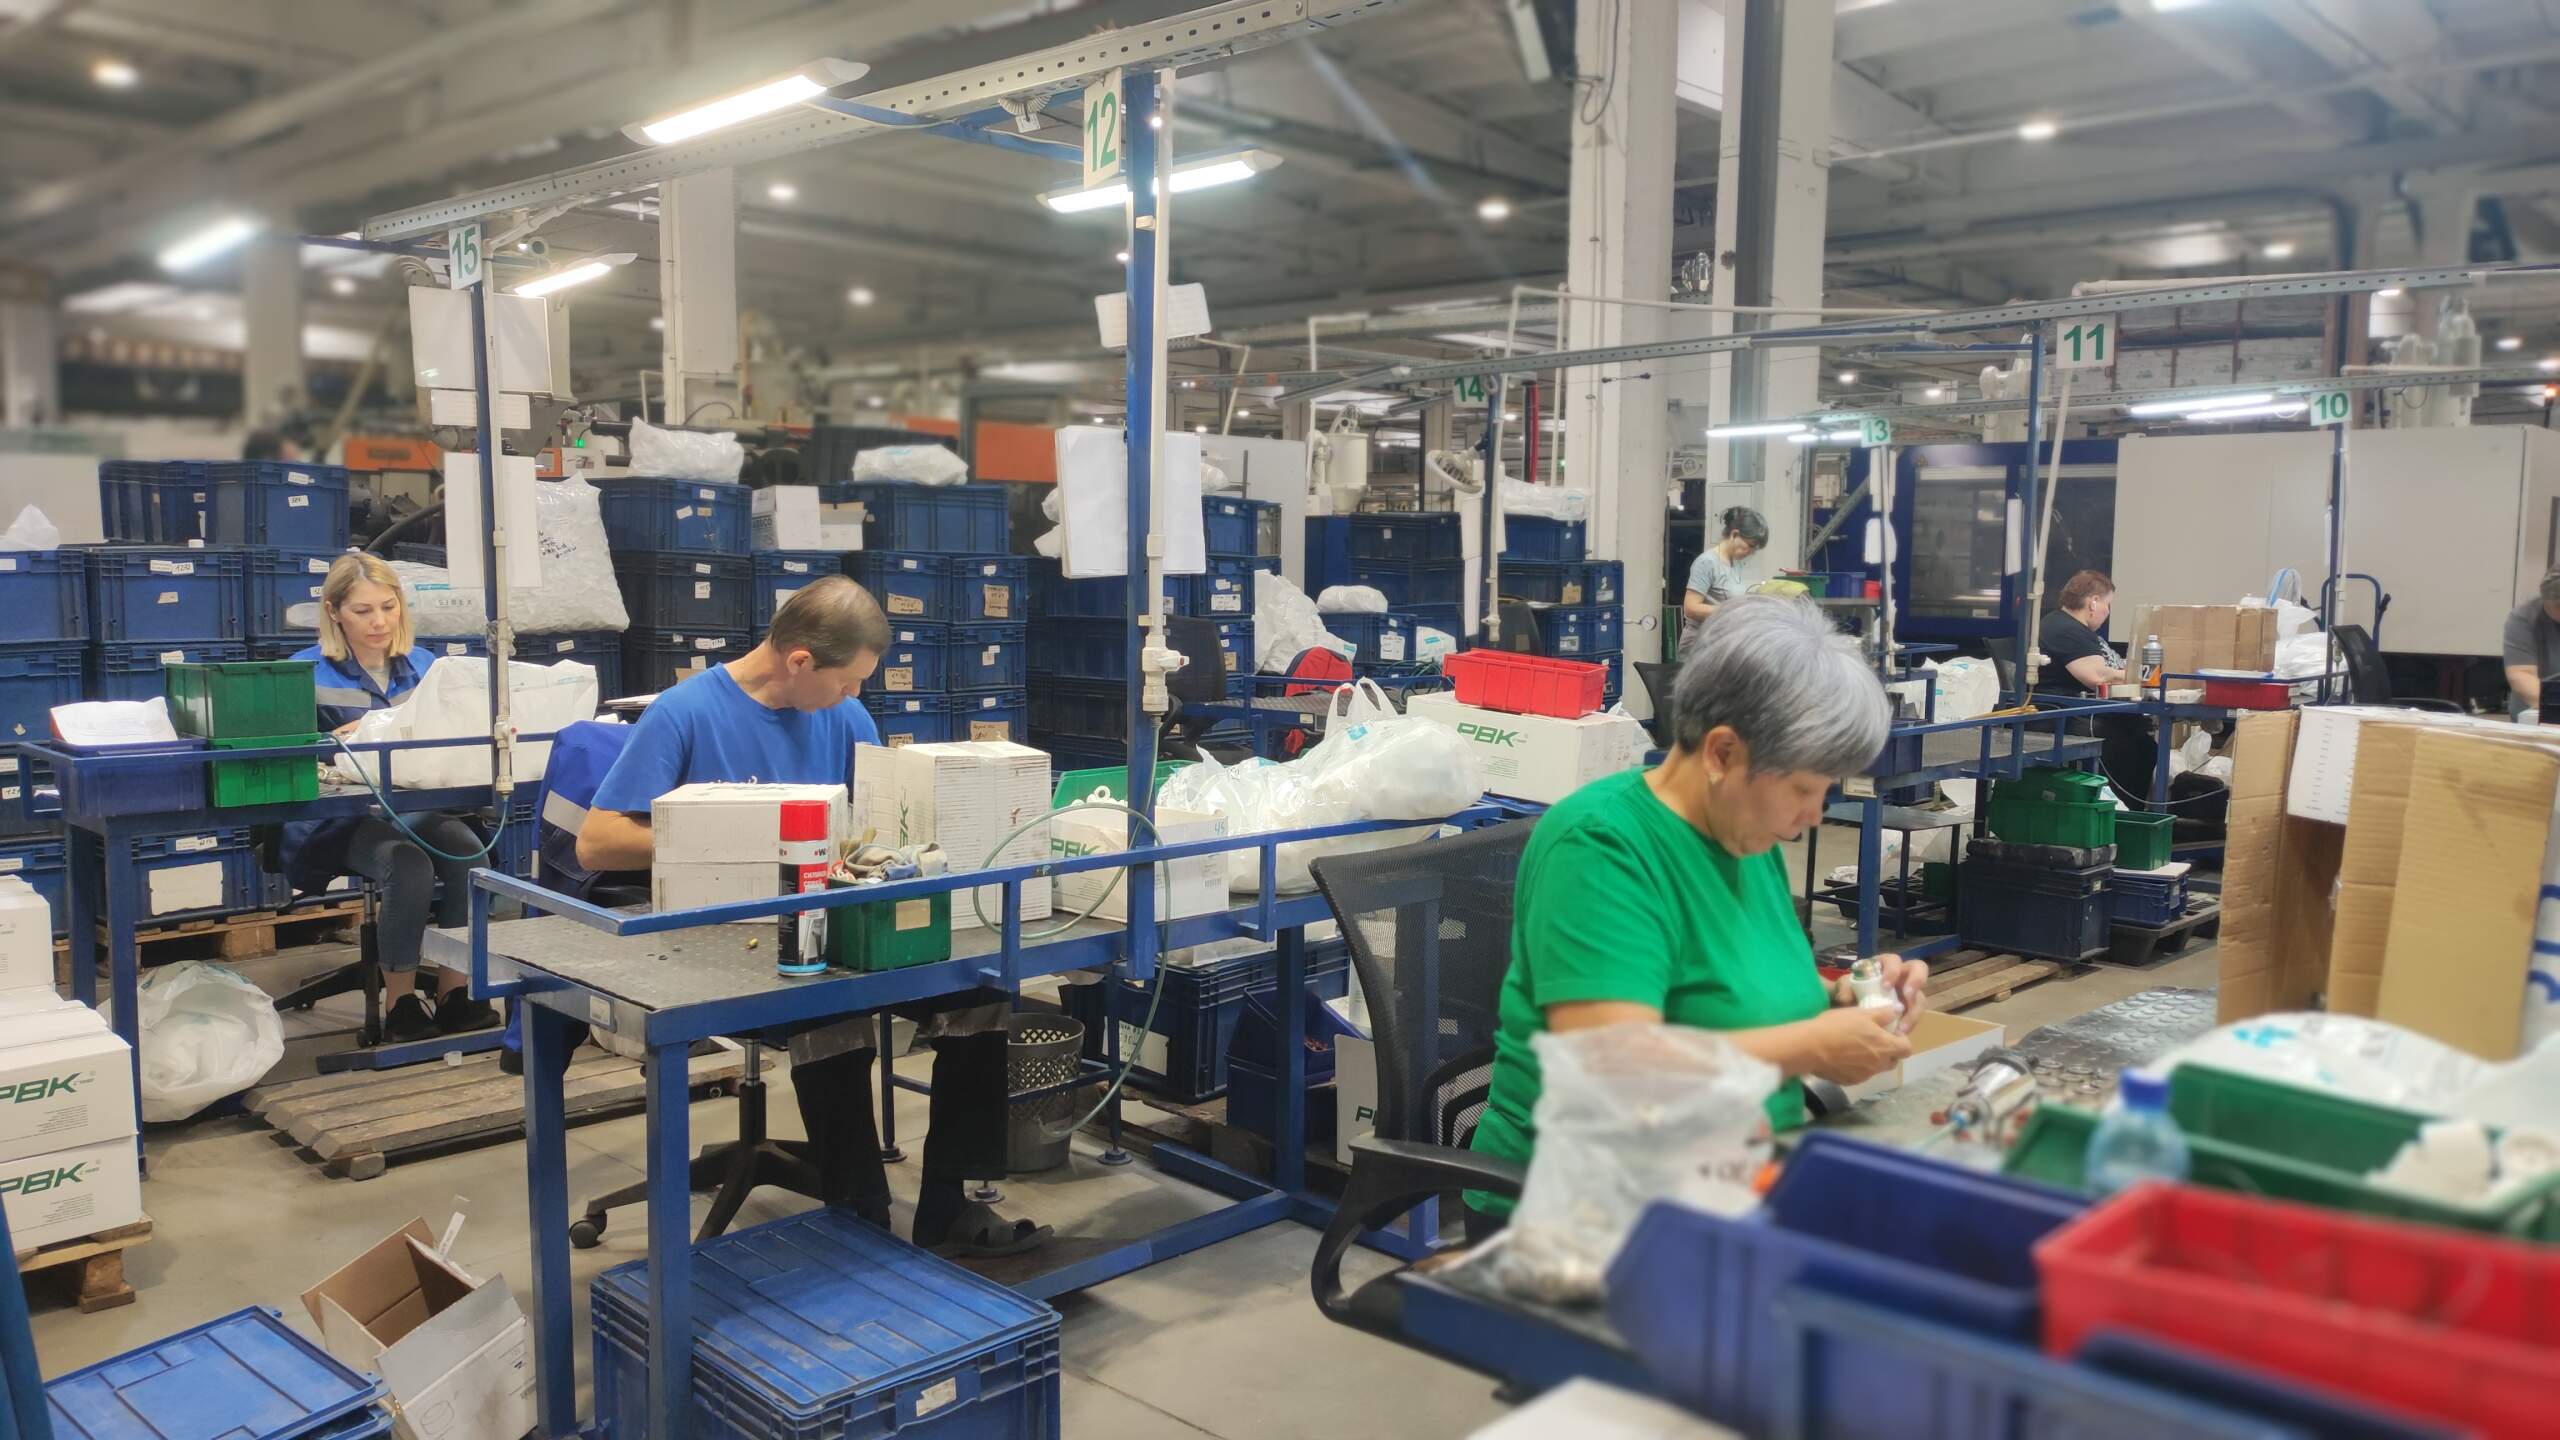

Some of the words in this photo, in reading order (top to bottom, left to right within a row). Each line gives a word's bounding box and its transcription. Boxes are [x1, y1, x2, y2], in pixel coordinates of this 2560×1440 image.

[1087, 91, 1116, 172] 12
[452, 227, 478, 280] 15
[2064, 323, 2104, 361] 11
[1455, 375, 1484, 402] 14
[2315, 392, 2348, 420] 10
[1866, 419, 1888, 442] 13
